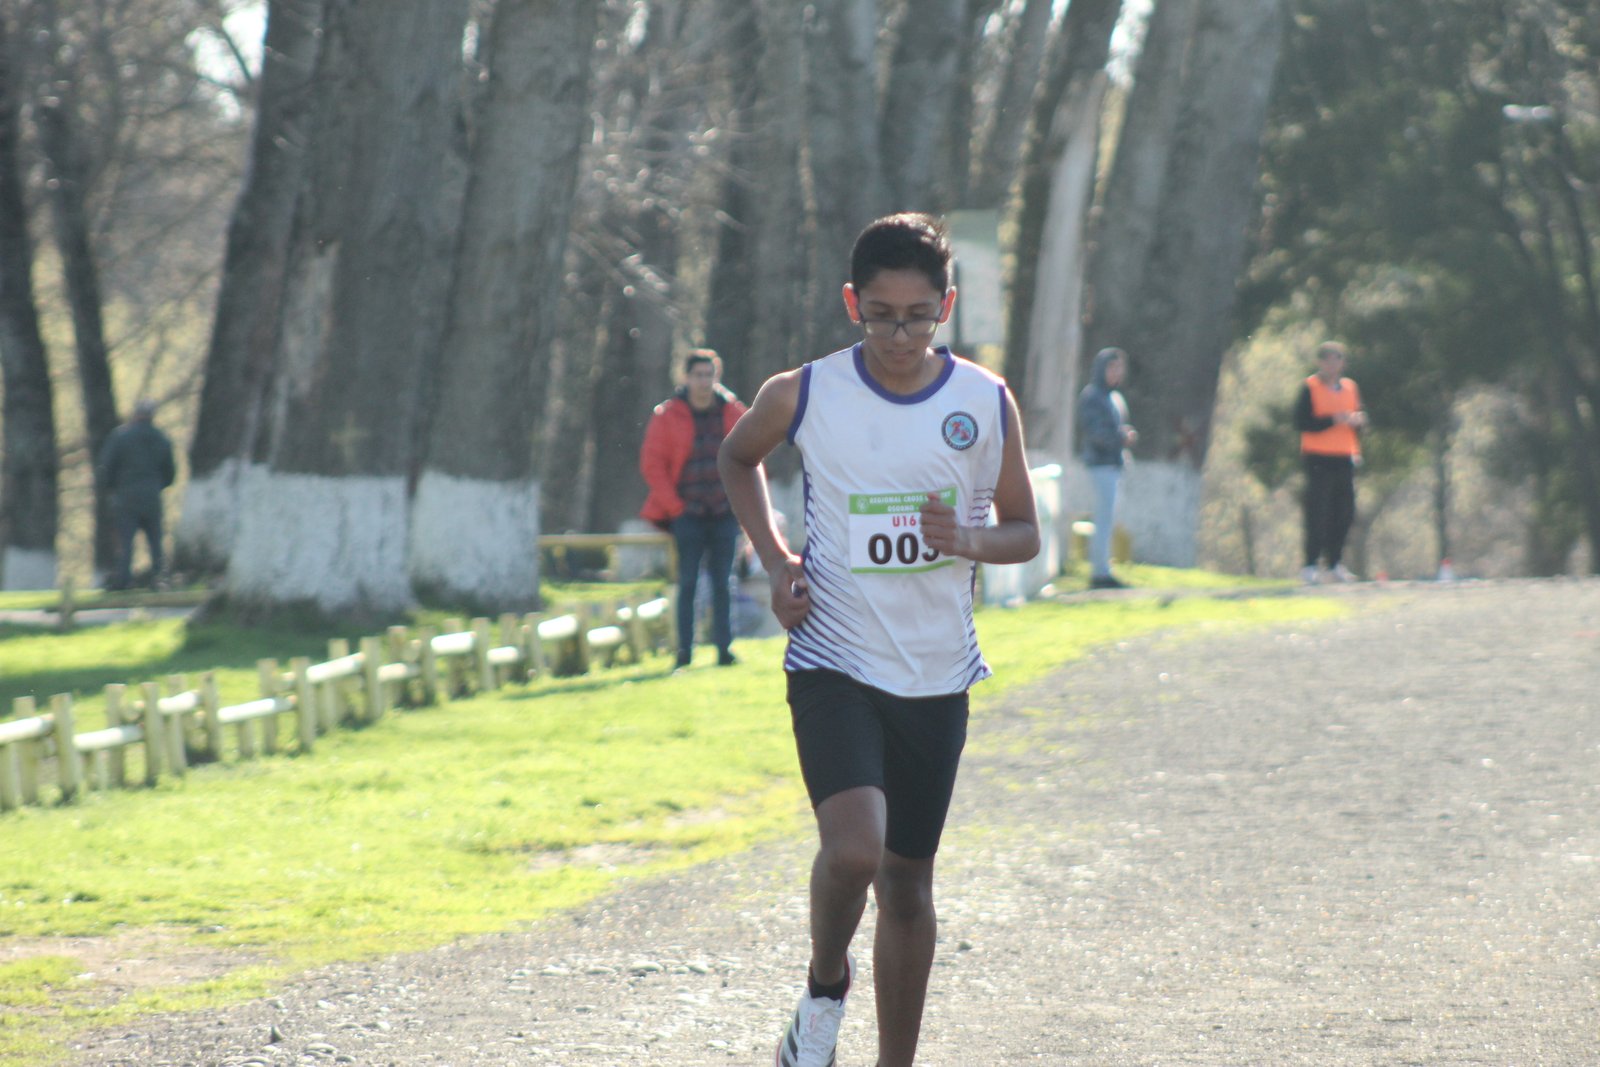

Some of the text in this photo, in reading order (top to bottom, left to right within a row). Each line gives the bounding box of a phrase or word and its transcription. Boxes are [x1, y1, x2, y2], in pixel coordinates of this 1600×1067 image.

[869, 496, 901, 504] REGIONAL
[904, 495, 924, 503] CROSS
[892, 515, 917, 527] U16
